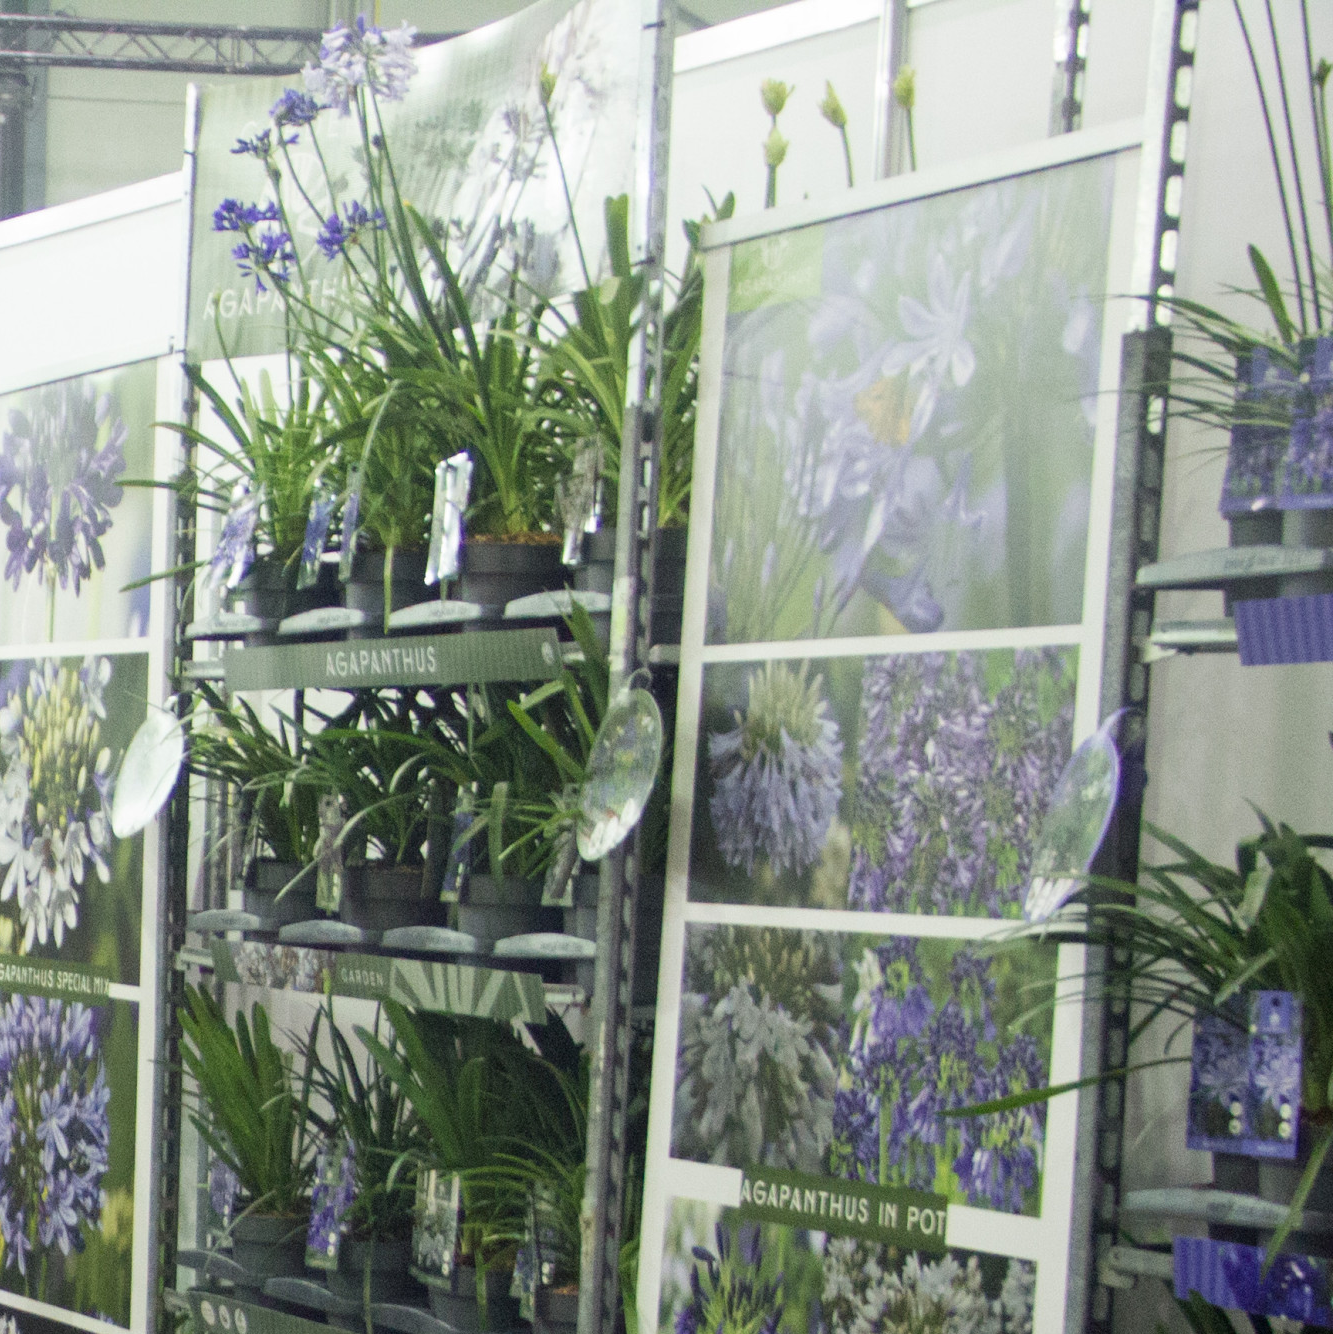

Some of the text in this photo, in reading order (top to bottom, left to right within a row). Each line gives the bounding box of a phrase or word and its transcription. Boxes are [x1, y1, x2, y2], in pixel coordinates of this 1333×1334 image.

[325, 646, 436, 676] AGAPANTHUS
[56, 971, 91, 993] SPECIAL
[94, 977, 110, 996] MIX
[741, 1179, 947, 1237] AGAPANTHUS IN POT
